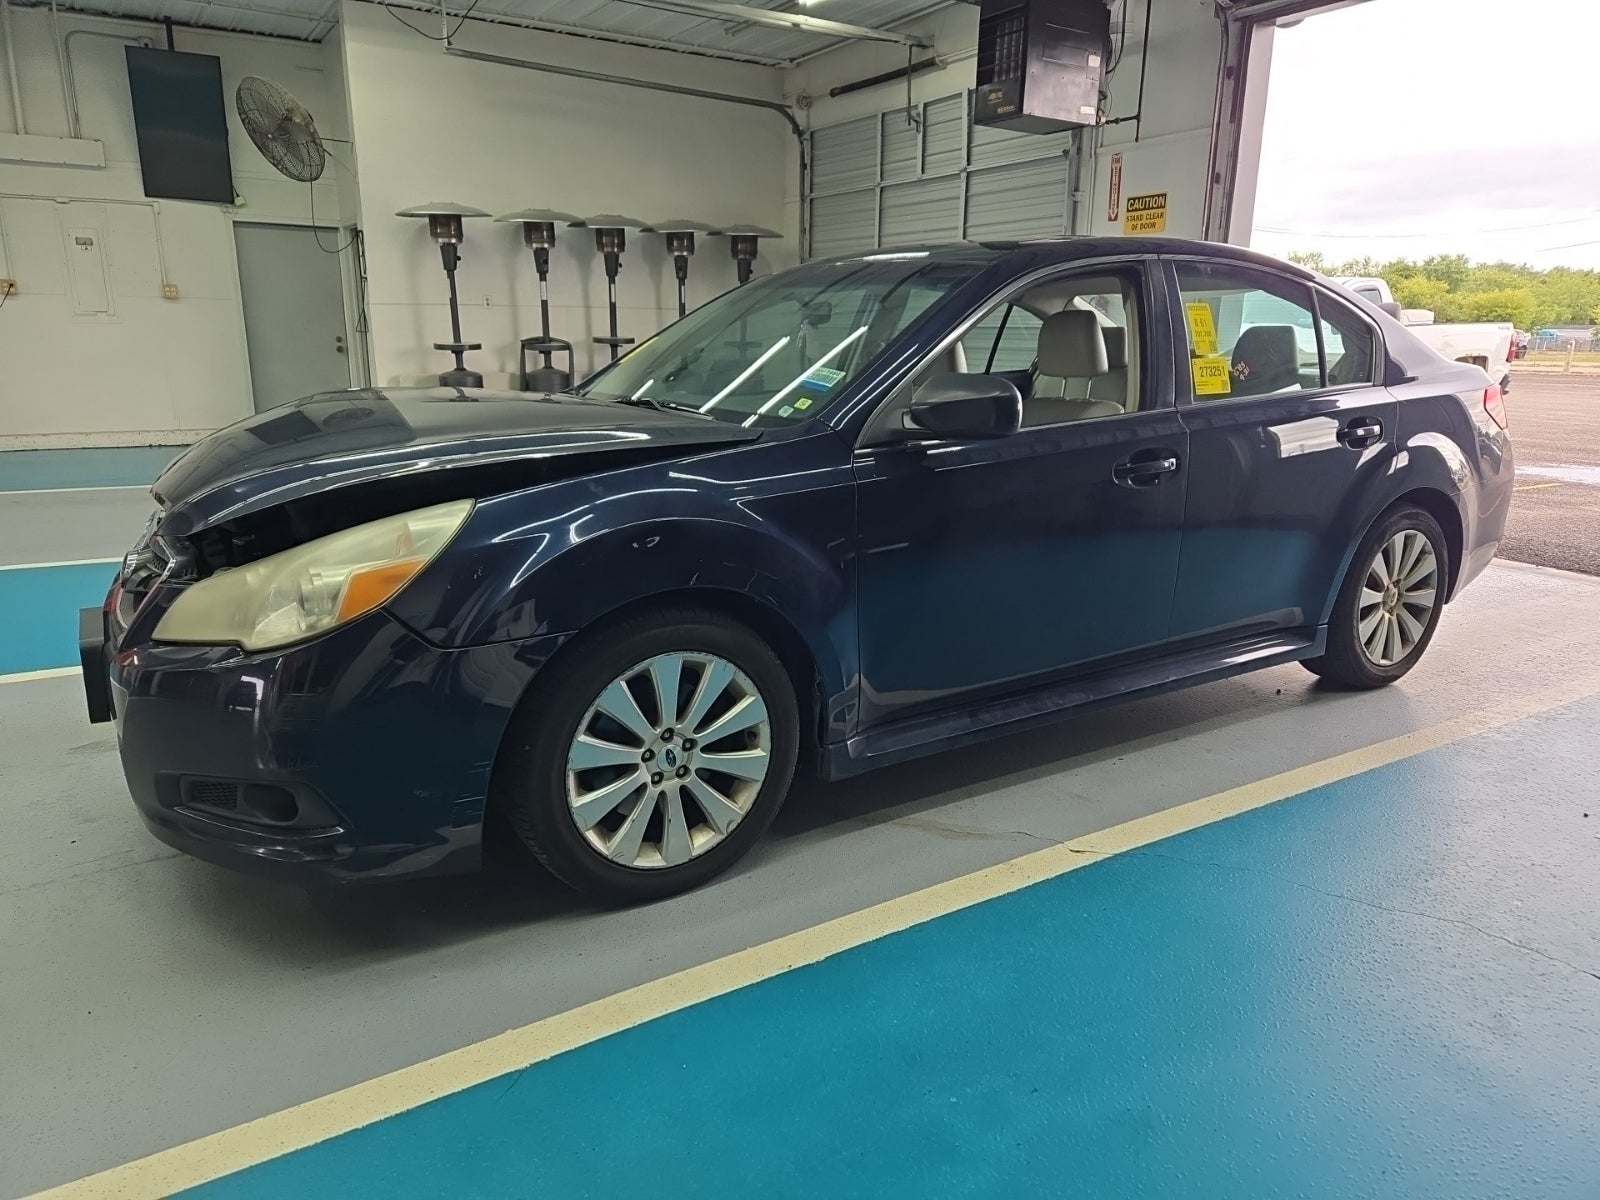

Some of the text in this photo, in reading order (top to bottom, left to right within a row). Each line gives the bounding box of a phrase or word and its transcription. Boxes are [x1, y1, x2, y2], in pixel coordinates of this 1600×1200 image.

[1127, 196, 1165, 210] CAUTION
[1126, 212, 1164, 222] STAND CLEAR
[1131, 222, 1156, 231] OF DOOR
[1199, 365, 1226, 377] 273251
